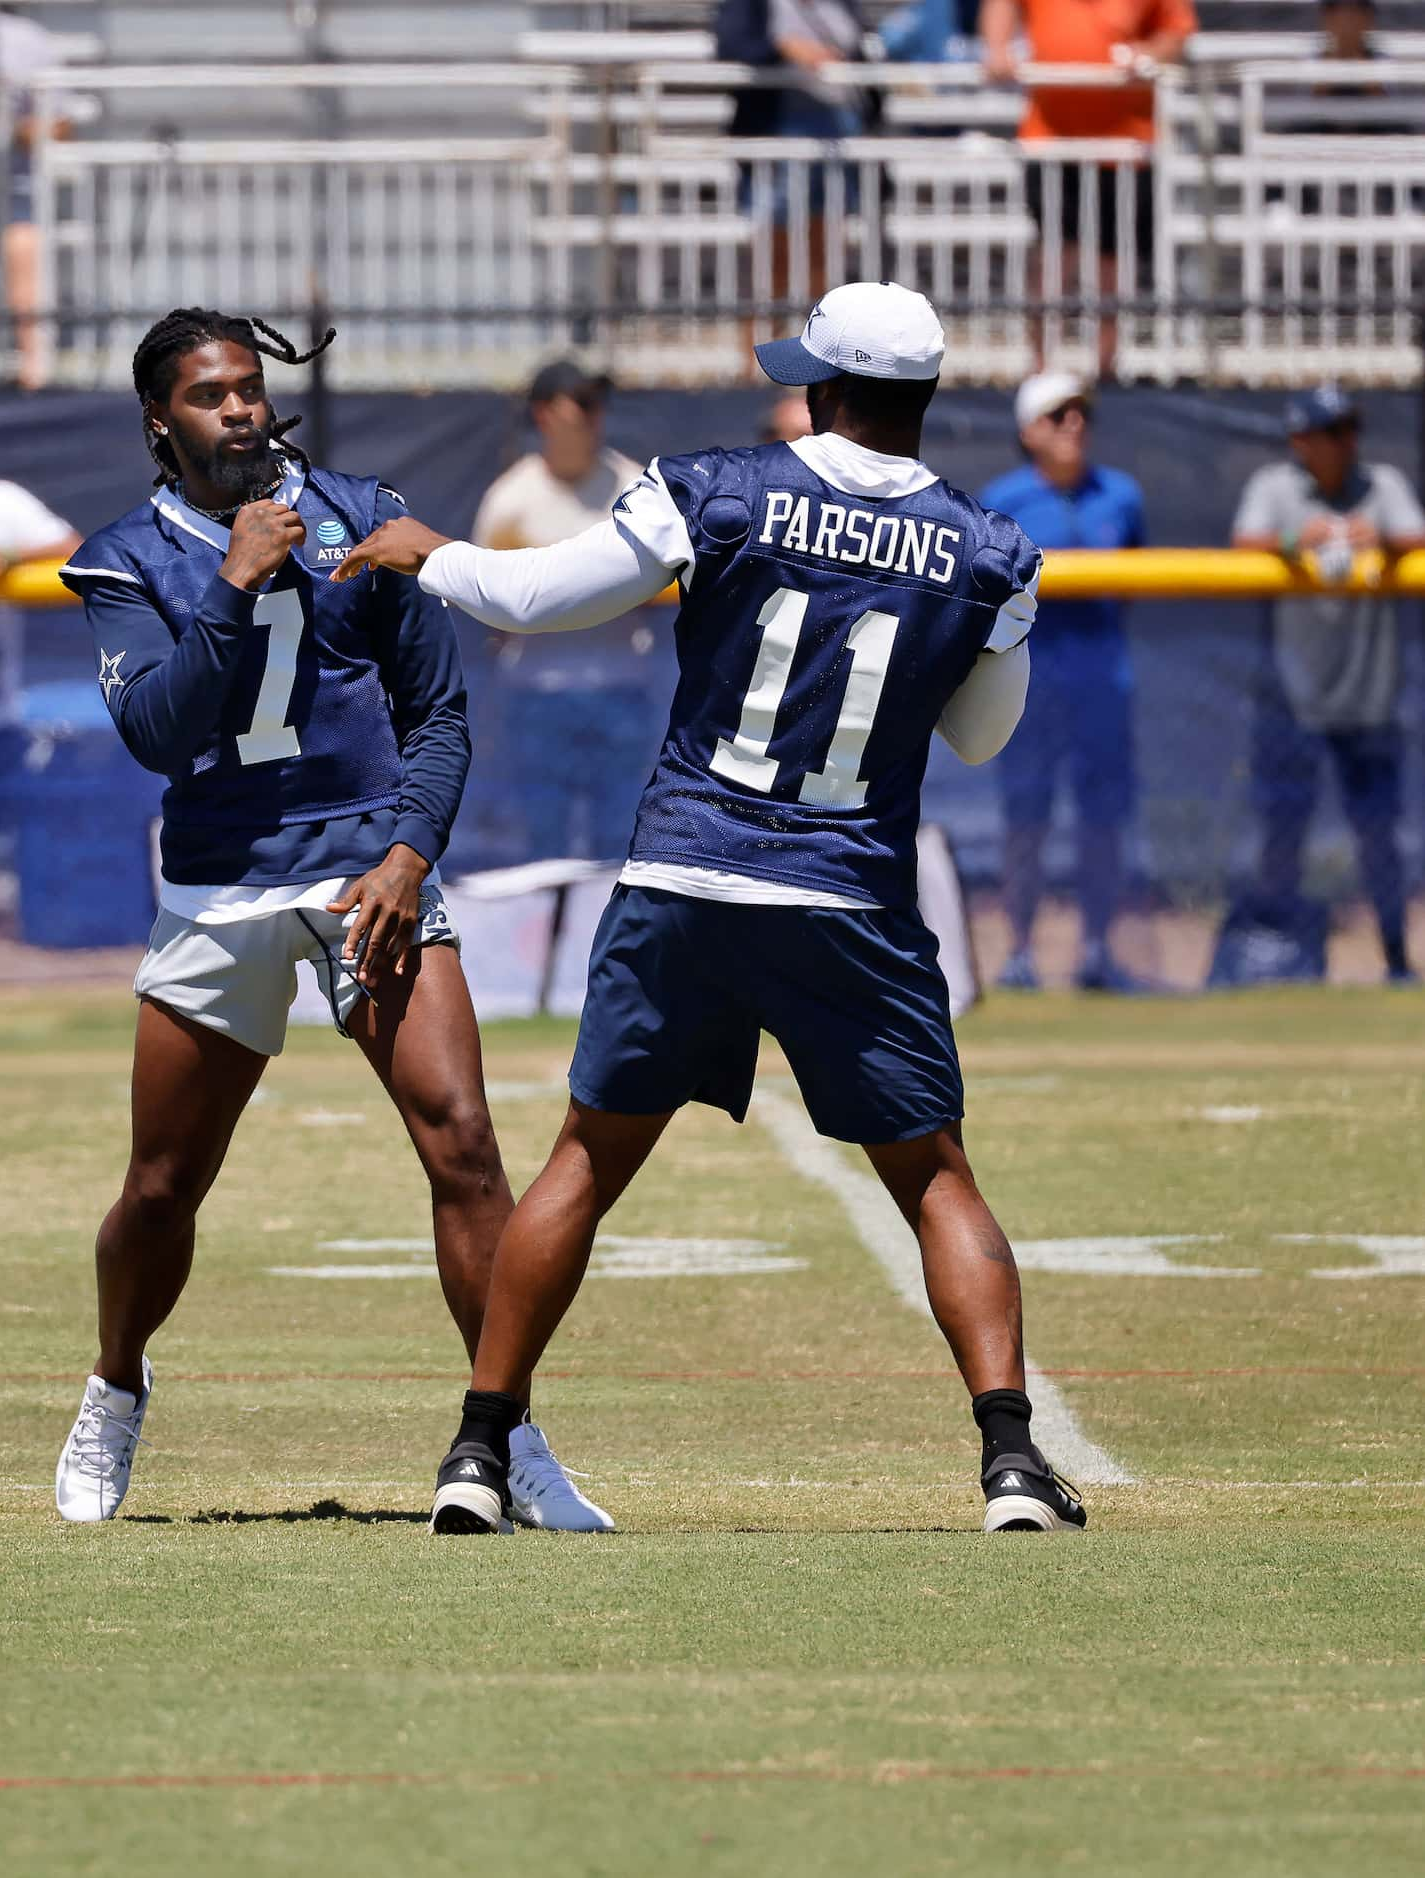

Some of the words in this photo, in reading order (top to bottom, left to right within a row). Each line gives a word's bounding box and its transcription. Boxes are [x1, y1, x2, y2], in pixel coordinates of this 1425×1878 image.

[317, 547, 351, 561] AT&T
[758, 491, 960, 584] PARSONS
[235, 588, 304, 766] 1
[709, 587, 901, 809] 11
